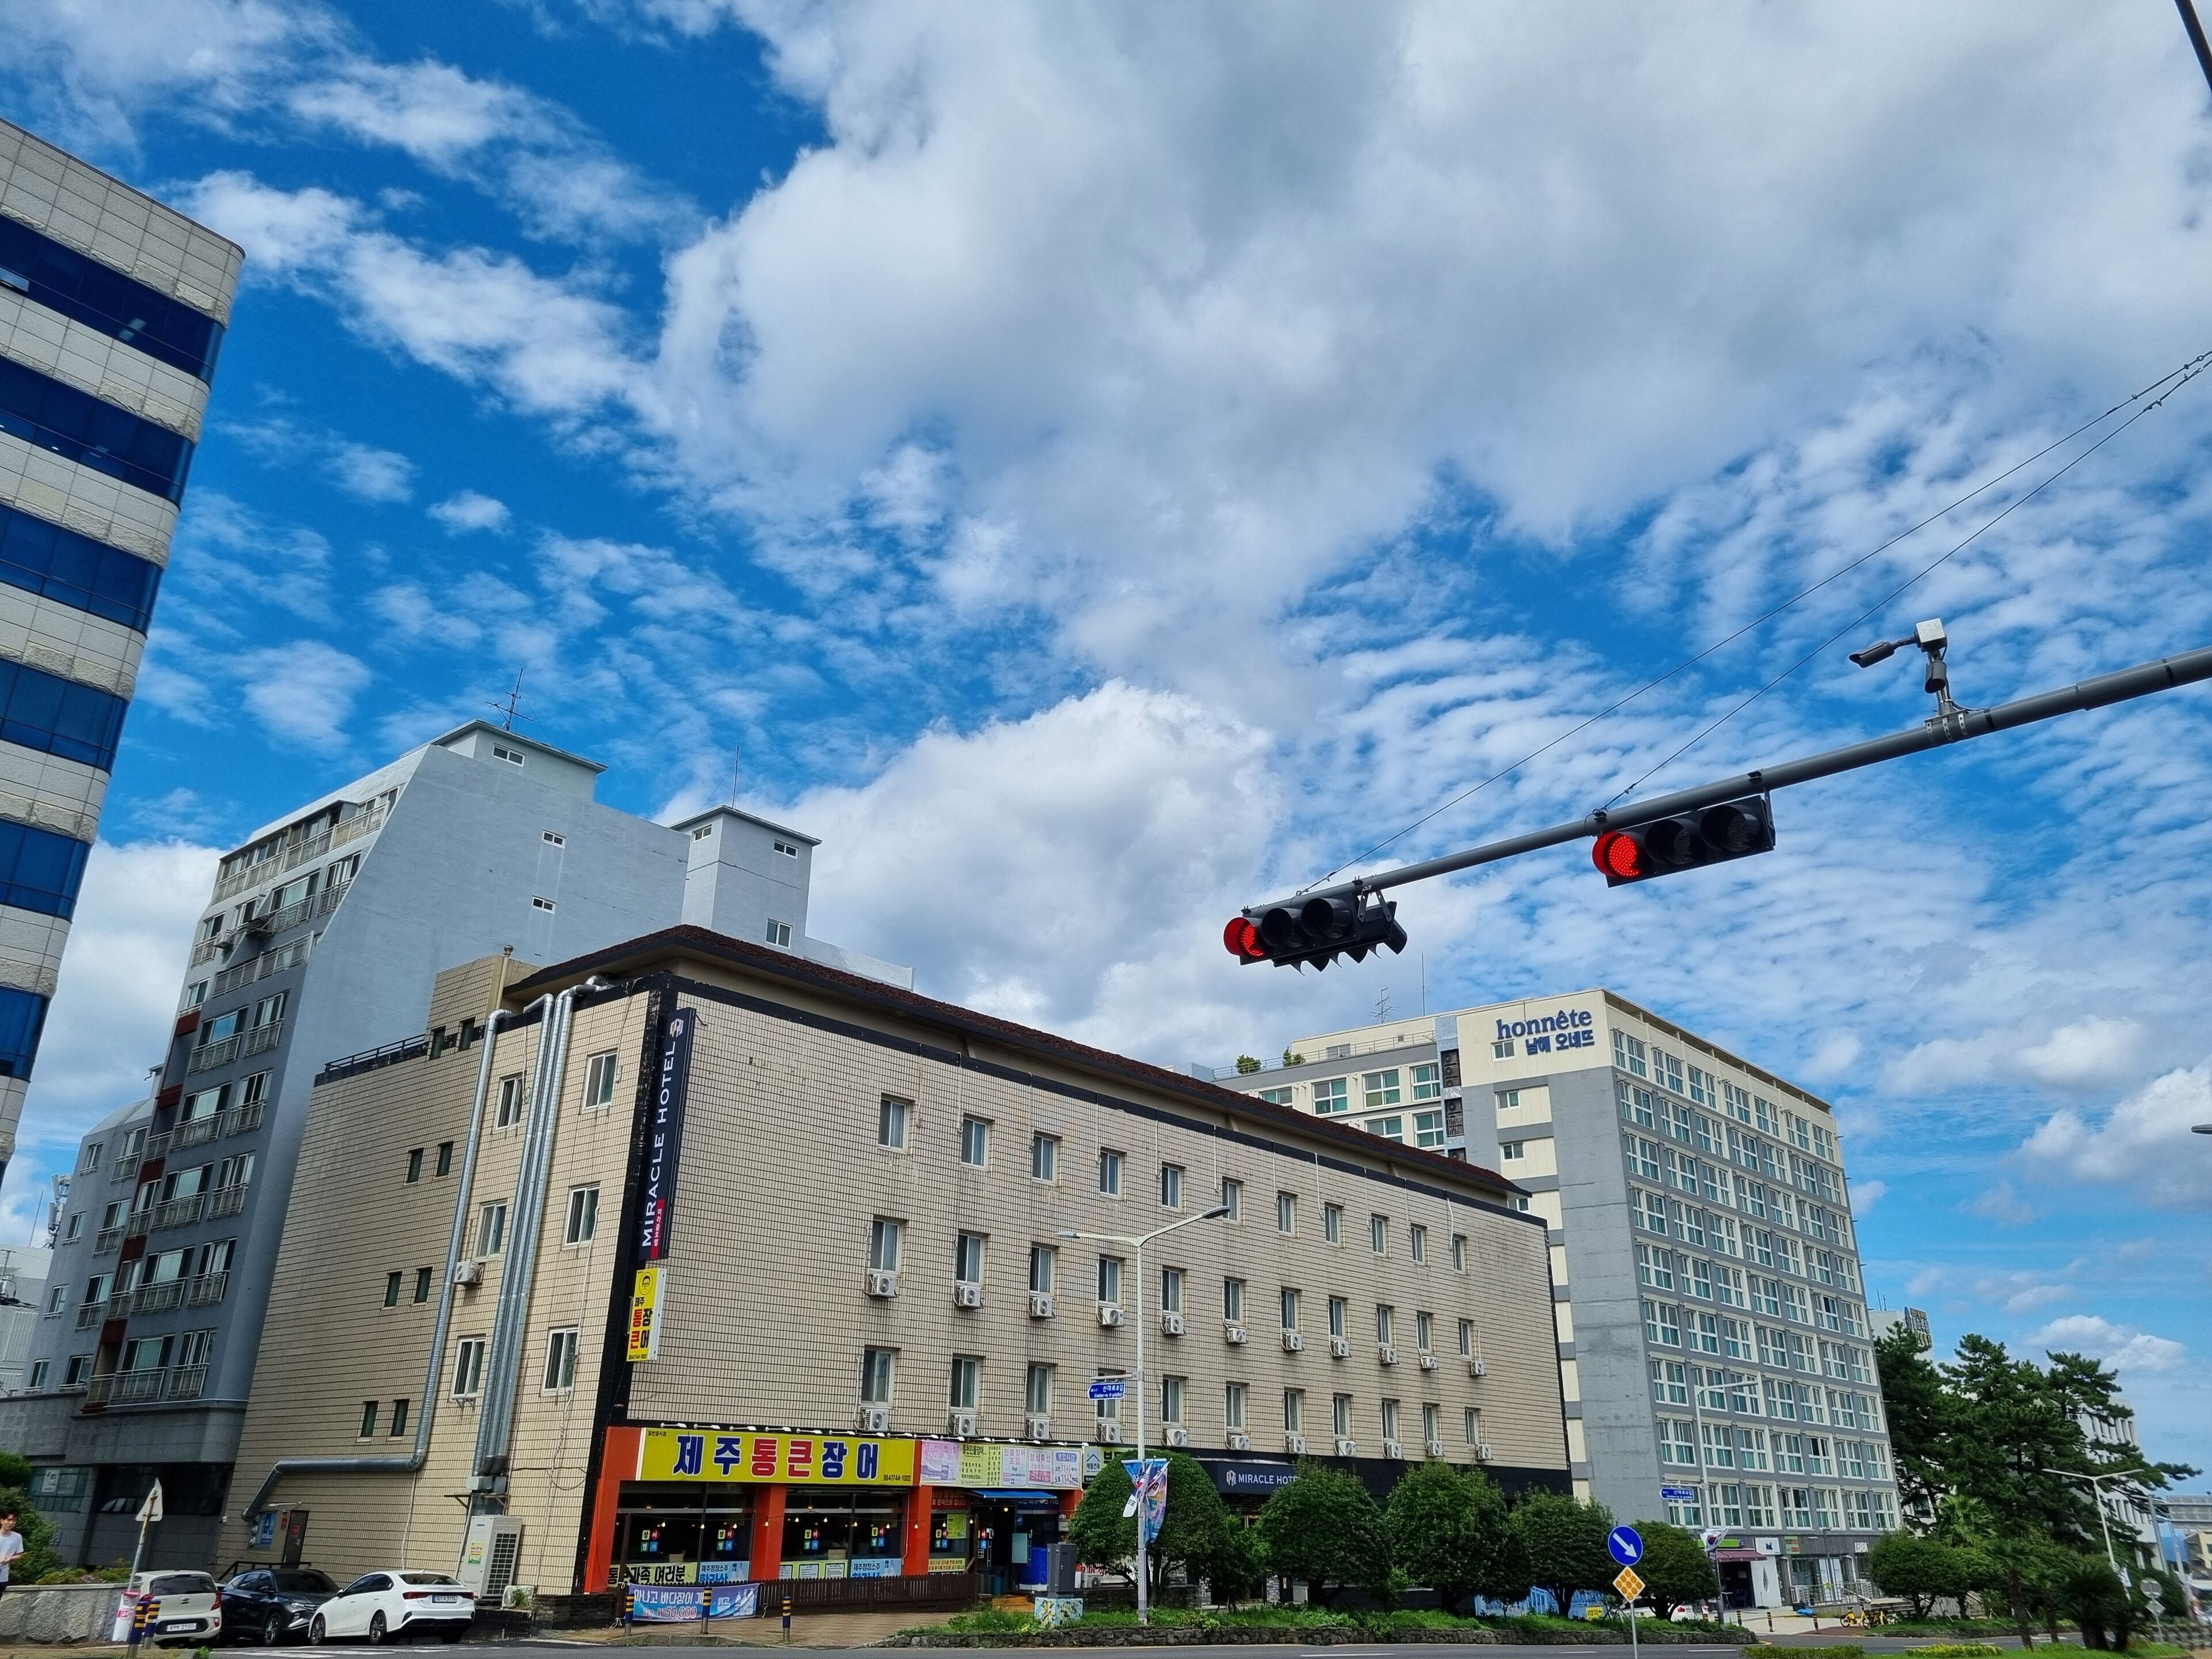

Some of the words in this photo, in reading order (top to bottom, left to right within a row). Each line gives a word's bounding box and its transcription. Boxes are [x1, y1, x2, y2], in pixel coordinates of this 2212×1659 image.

[1496, 1009, 1592, 1039] honnête
[642, 1132, 665, 1247] MIRACLE
[657, 1041, 676, 1123] HOTEL
[1238, 1474, 1274, 1484] MIRACLE
[1277, 1475, 1299, 1484] HOT
[654, 1565, 685, 1582] 여러분
[634, 1589, 658, 1604] 아나고
[661, 1591, 694, 1604] 바다장어
